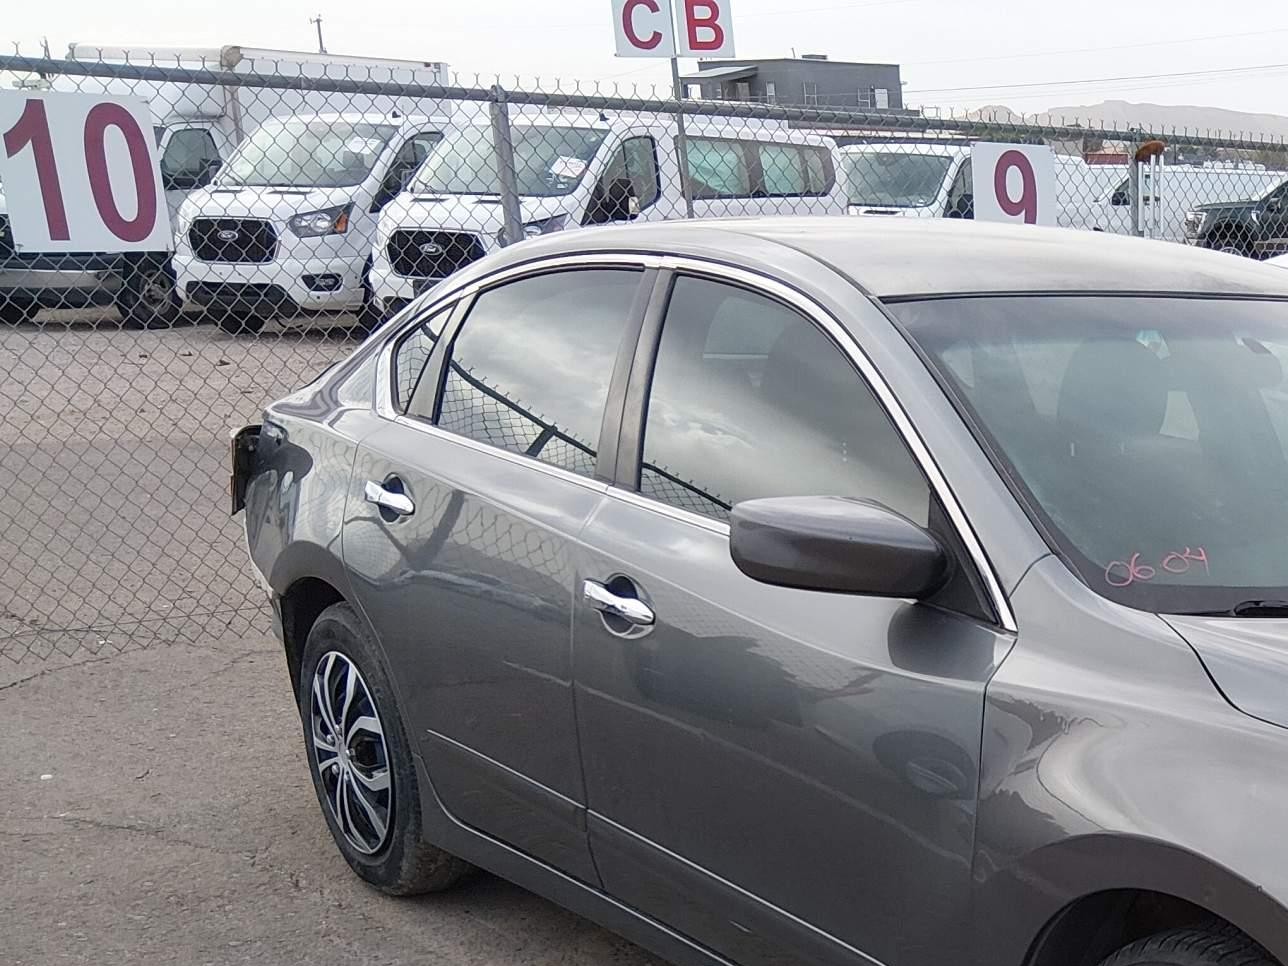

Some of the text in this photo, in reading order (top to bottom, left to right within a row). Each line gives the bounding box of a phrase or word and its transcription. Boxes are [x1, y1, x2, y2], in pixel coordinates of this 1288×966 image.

[622, 0, 663, 50] C
[684, 0, 725, 50] B
[3, 98, 157, 243] 10
[994, 149, 1038, 225] 9
